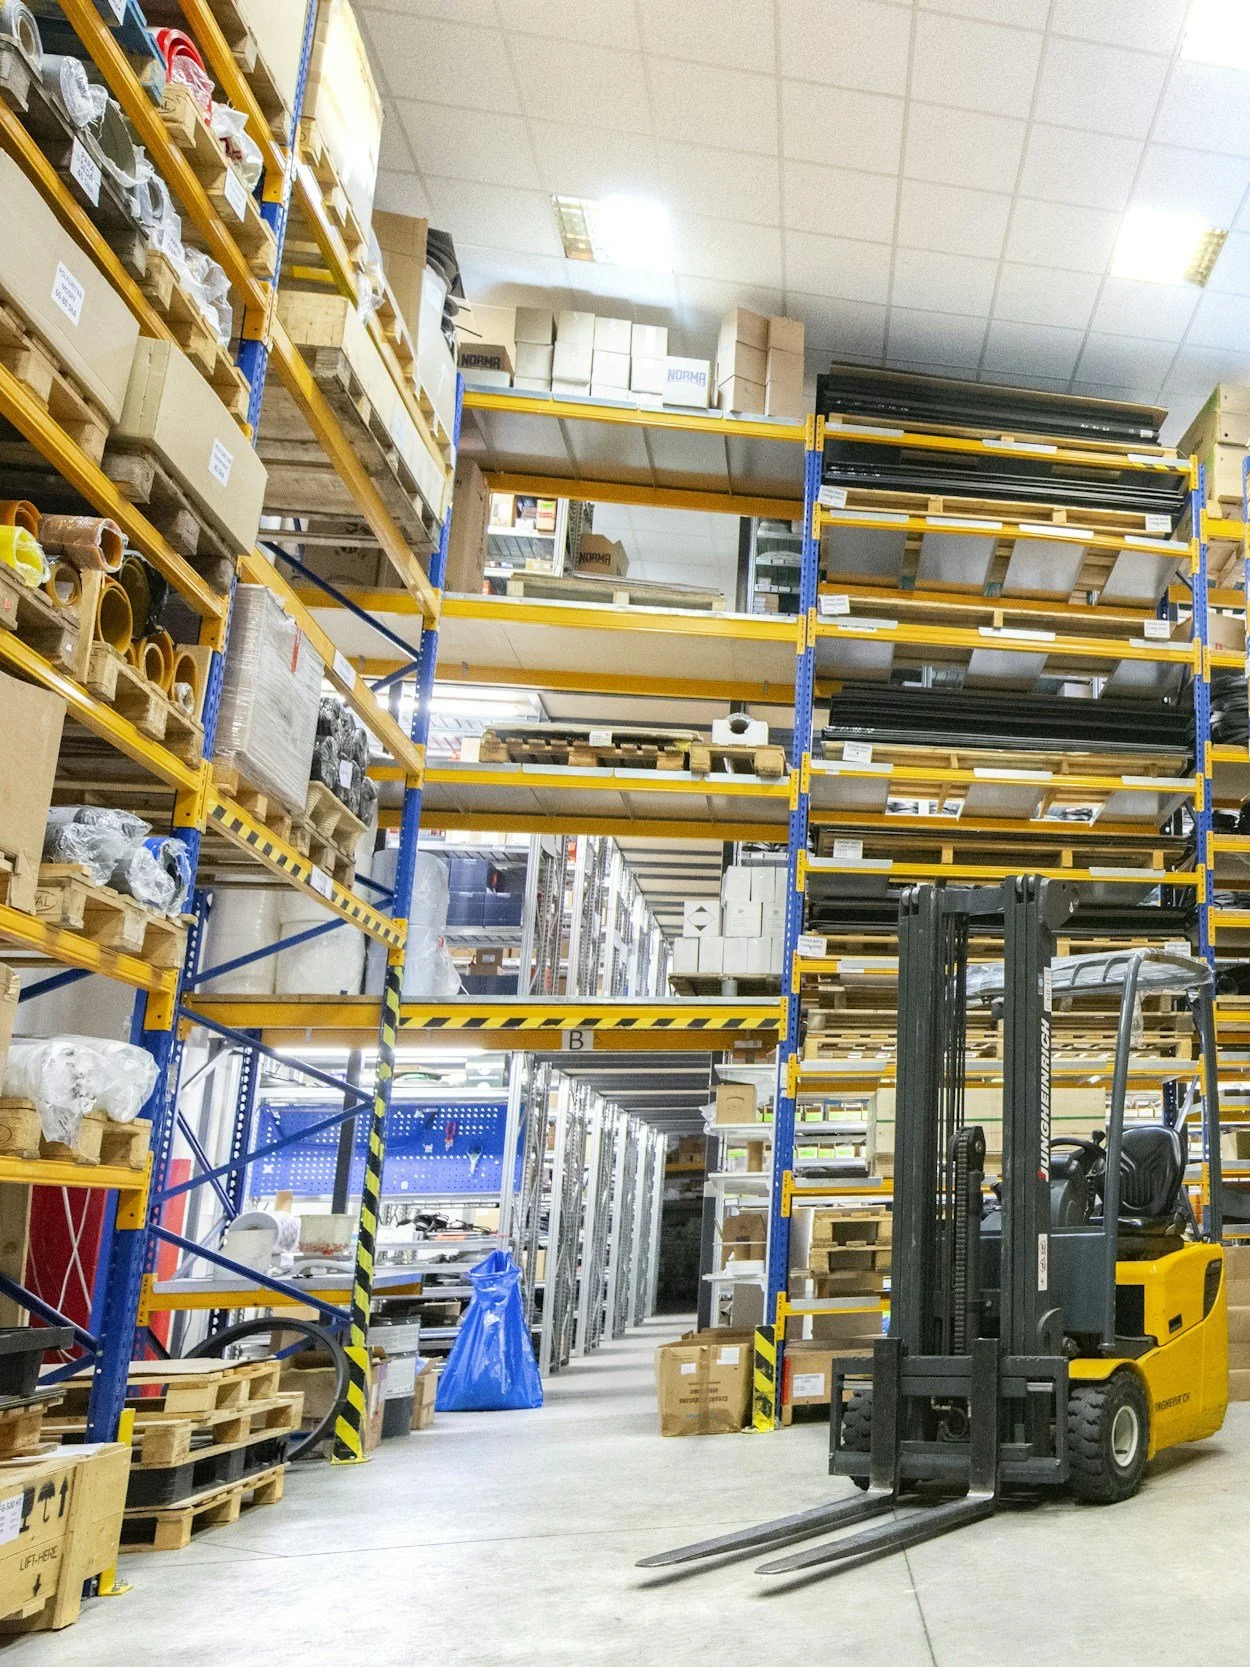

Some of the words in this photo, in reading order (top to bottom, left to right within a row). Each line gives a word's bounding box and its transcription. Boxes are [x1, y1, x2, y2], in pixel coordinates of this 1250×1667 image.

[461, 354, 500, 369] NORMA
[667, 368, 706, 385] NORMA
[569, 1030, 583, 1051] B
[1037, 1018, 1050, 1182] JUNGHEINRICH
[19, 1545, 58, 1571] LIFT-HERE
